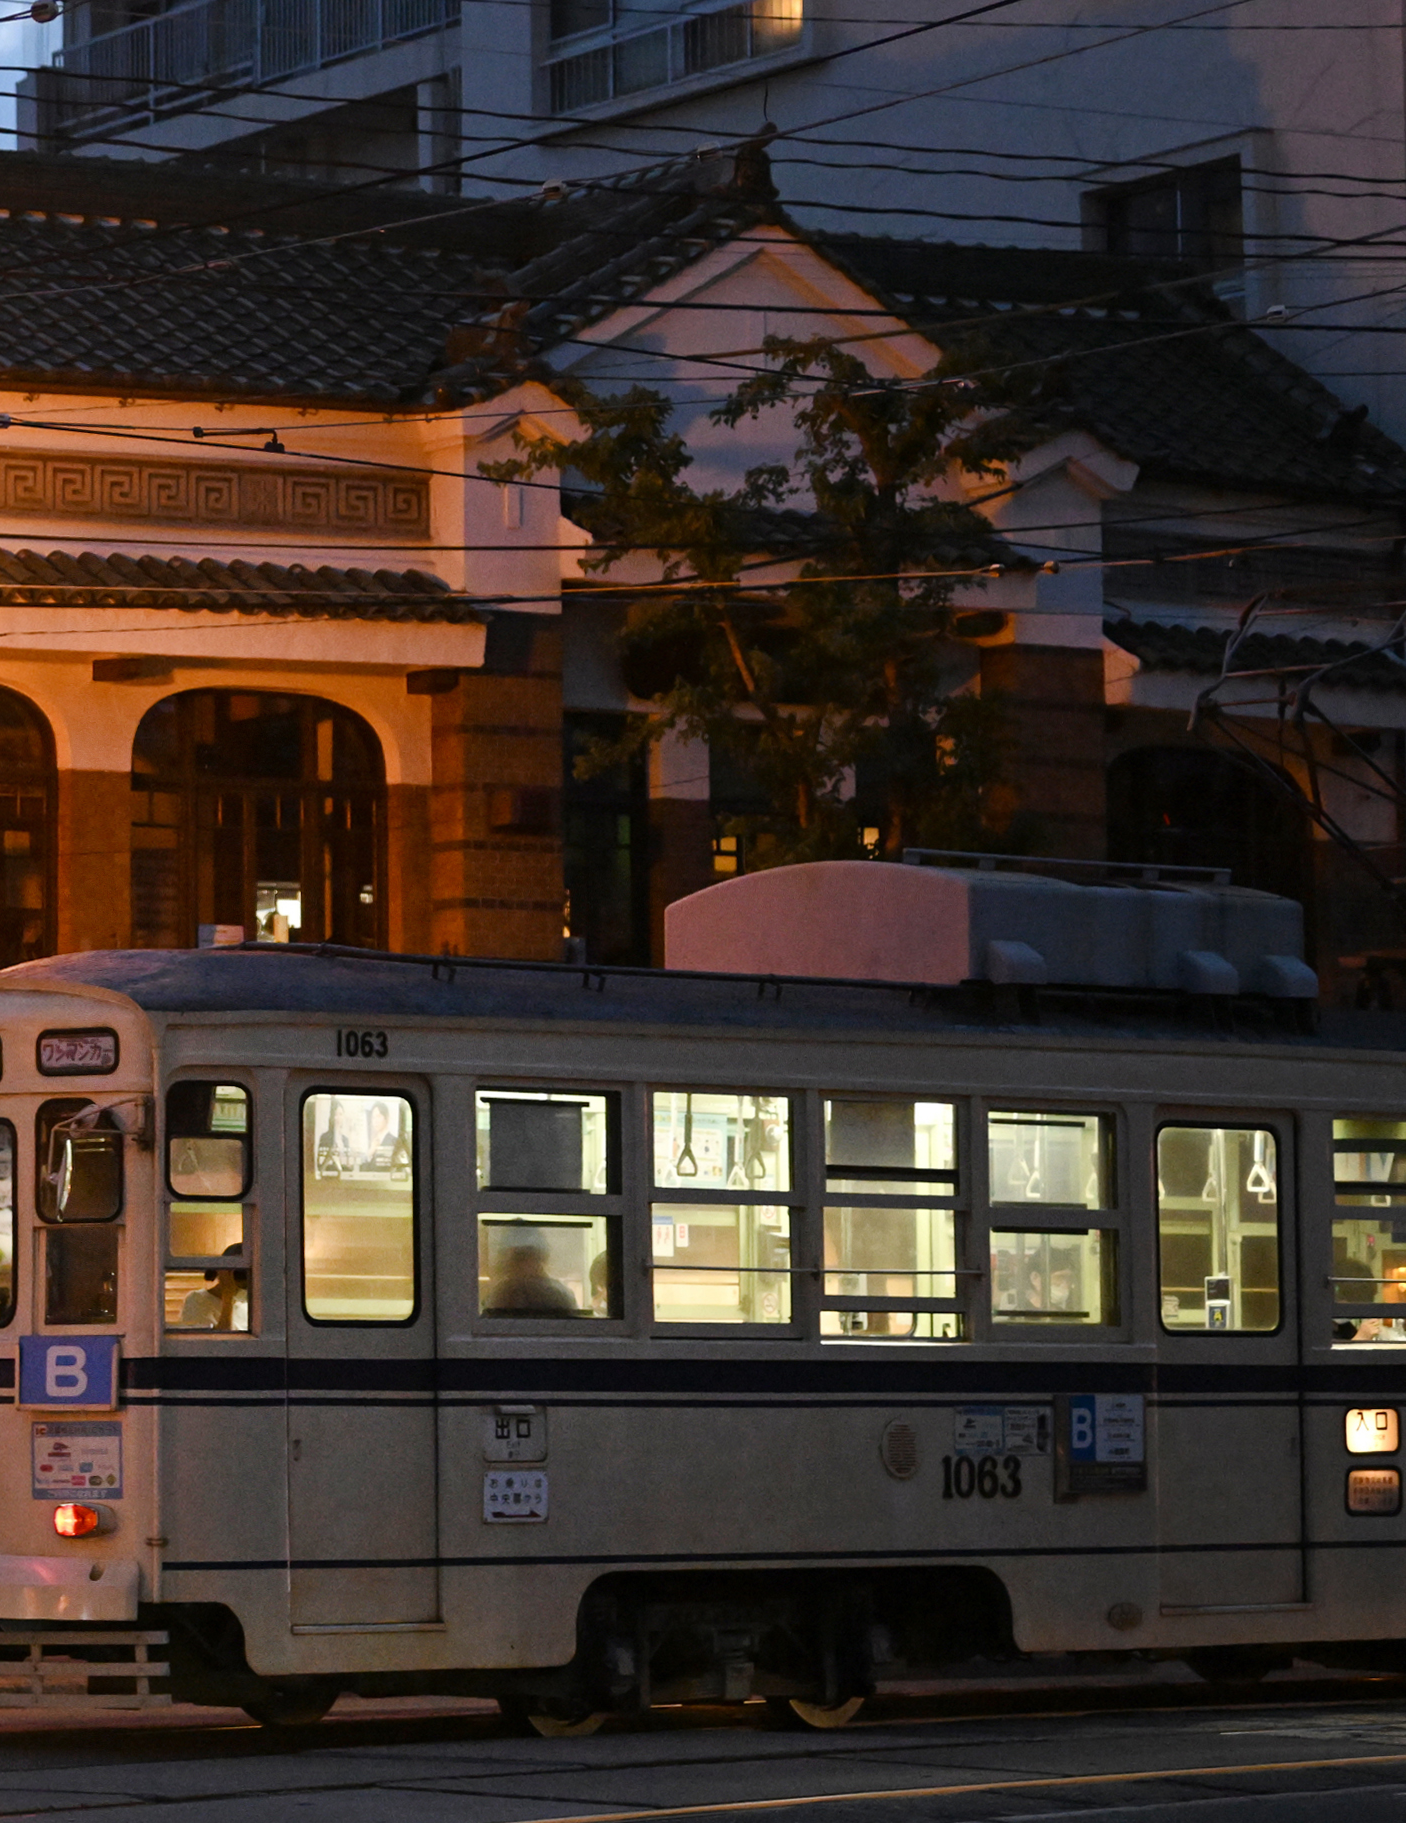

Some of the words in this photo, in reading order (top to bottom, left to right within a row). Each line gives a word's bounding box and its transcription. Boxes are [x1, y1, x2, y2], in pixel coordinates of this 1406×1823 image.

[42, 1043, 114, 1064] ワンマンカー
[335, 1029, 388, 1058] 1063
[45, 1346, 88, 1396] B
[495, 1418, 531, 1439] 出口
[1072, 1408, 1092, 1449] B
[1356, 1412, 1388, 1431] 入口
[942, 1454, 1022, 1499] 1063
